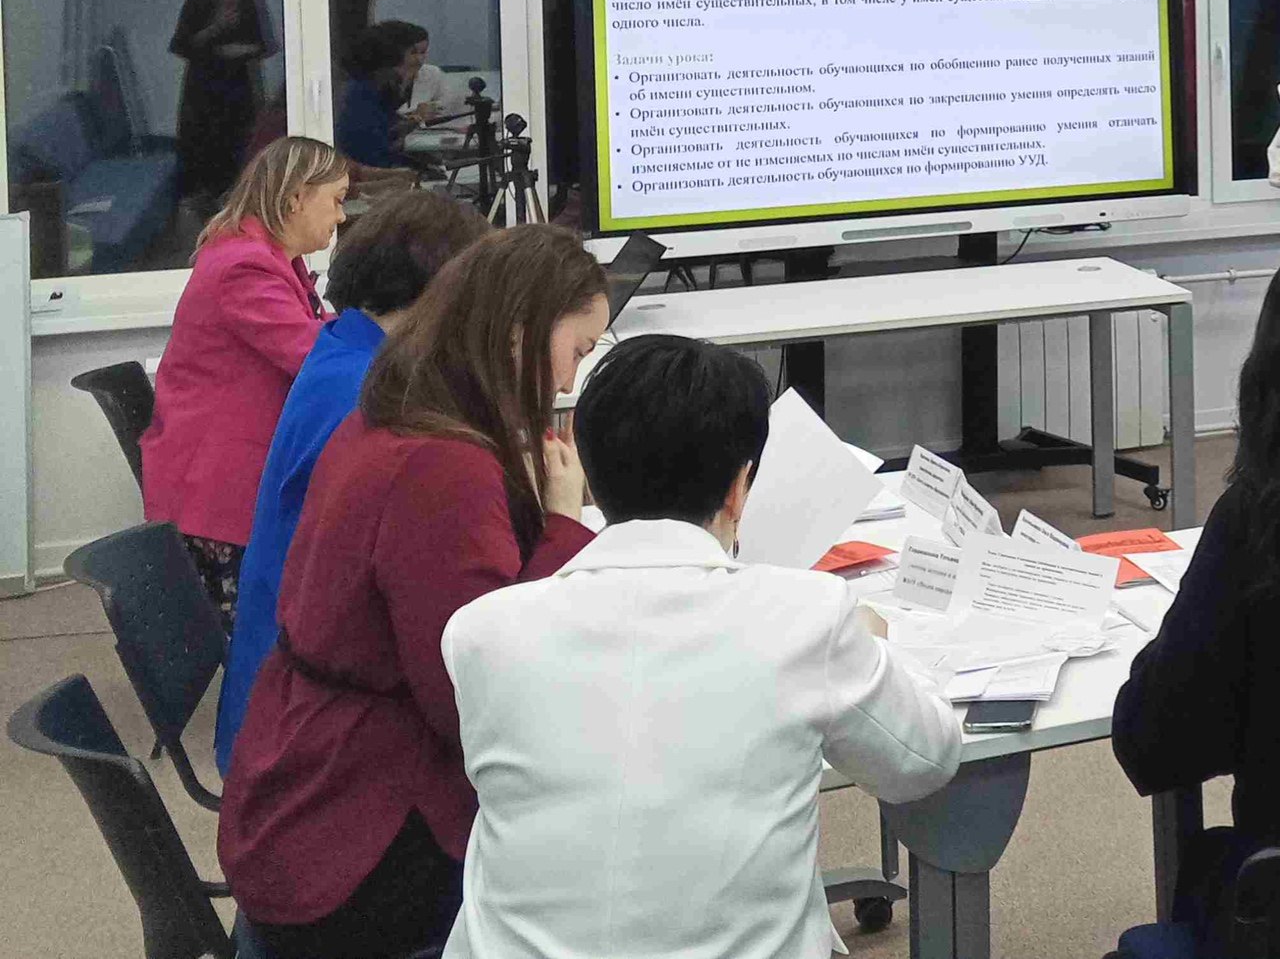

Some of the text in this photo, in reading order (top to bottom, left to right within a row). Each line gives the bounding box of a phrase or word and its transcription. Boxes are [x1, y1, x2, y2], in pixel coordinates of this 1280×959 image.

[611, 0, 652, 10] число
[611, 17, 705, 30] одного числа.
[613, 52, 715, 66] Задачи урока:
[628, 48, 1156, 84] Организовать деятельность обучающихся по обобщению ранее полученных знаний
[628, 83, 816, 100] об имени существительном.
[629, 83, 1157, 120] Организовать деятельность обучающихся по закреплению умения определять число
[629, 119, 791, 137] имён существительных.
[630, 116, 1158, 157] Организовать деятельность обучающихся по формированию умения отличать
[631, 140, 1046, 173] изменяемые от не изменяемых по числам имён существительных.
[631, 154, 1049, 193] Организовать деятельность обучающихся по формированию УУД.
